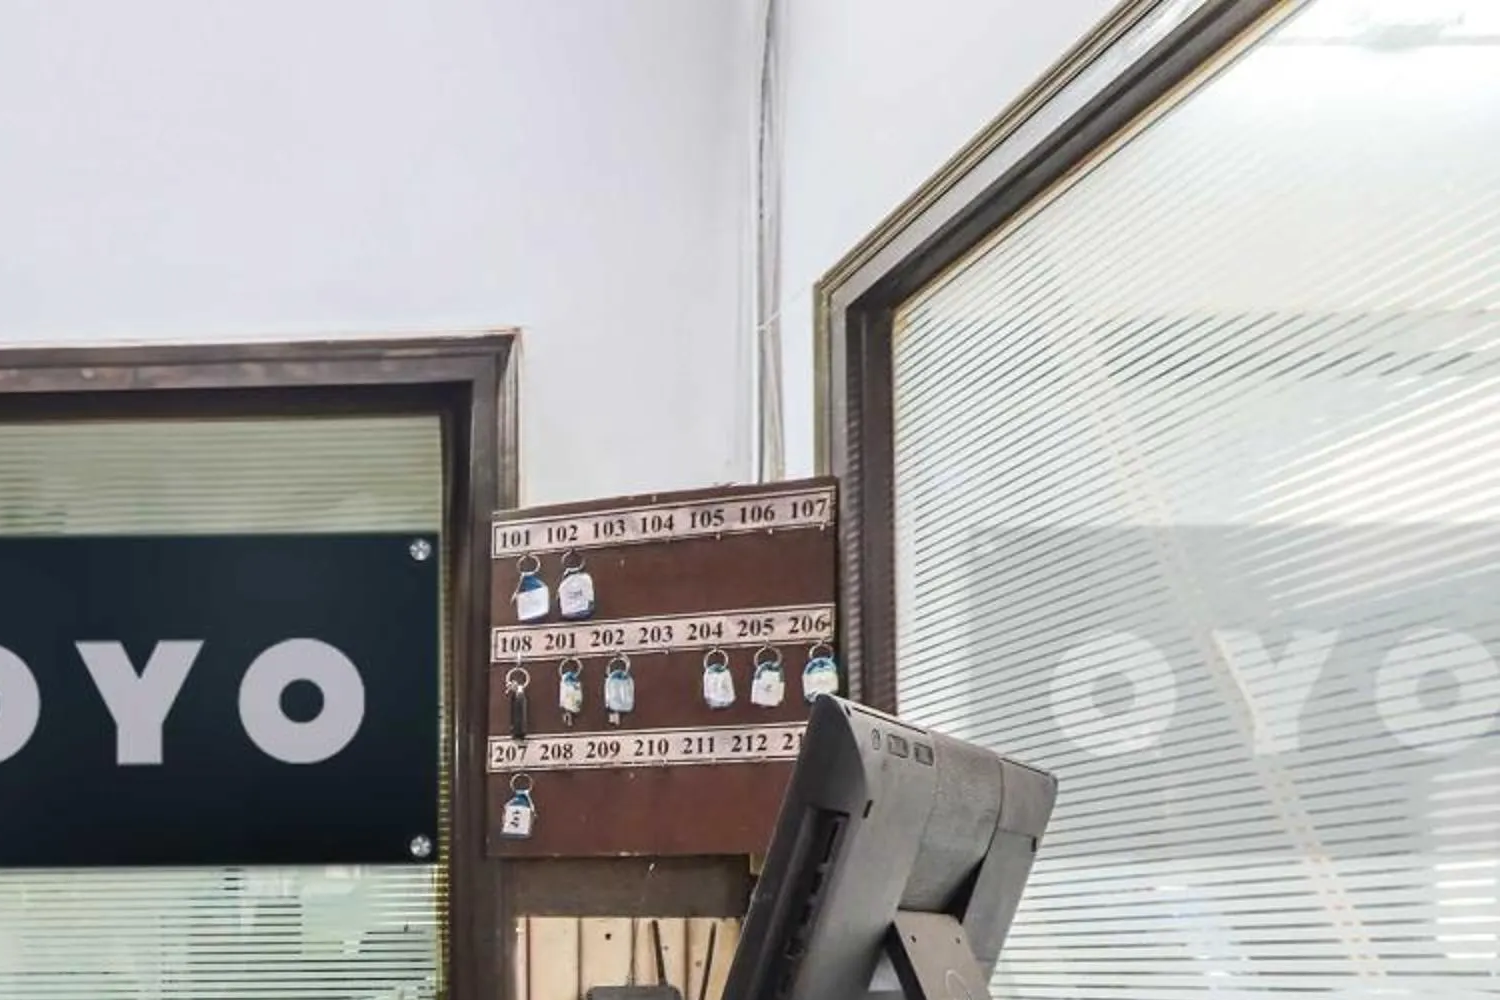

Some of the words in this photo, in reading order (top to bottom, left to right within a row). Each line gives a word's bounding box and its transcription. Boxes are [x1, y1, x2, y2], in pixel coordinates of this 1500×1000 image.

[500, 529, 531, 548] 101
[546, 524, 579, 543] 102
[592, 519, 626, 539] 103
[640, 514, 675, 534] 104
[689, 508, 725, 530] 105
[739, 503, 775, 525] 106
[790, 498, 828, 520] 107
[501, 634, 533, 653] 108
[544, 632, 576, 651] 201
[590, 628, 625, 648] 202
[638, 624, 674, 644] 203
[687, 620, 723, 641] 204
[737, 617, 774, 638] 205
[788, 613, 827, 635] 206
[494, 745, 528, 763] 207
[540, 742, 574, 761] 208
[585, 740, 621, 759] 209
[633, 737, 669, 757] 210
[683, 735, 716, 754] 211
[731, 733, 768, 753] 212
[782, 732, 804, 752] 21
